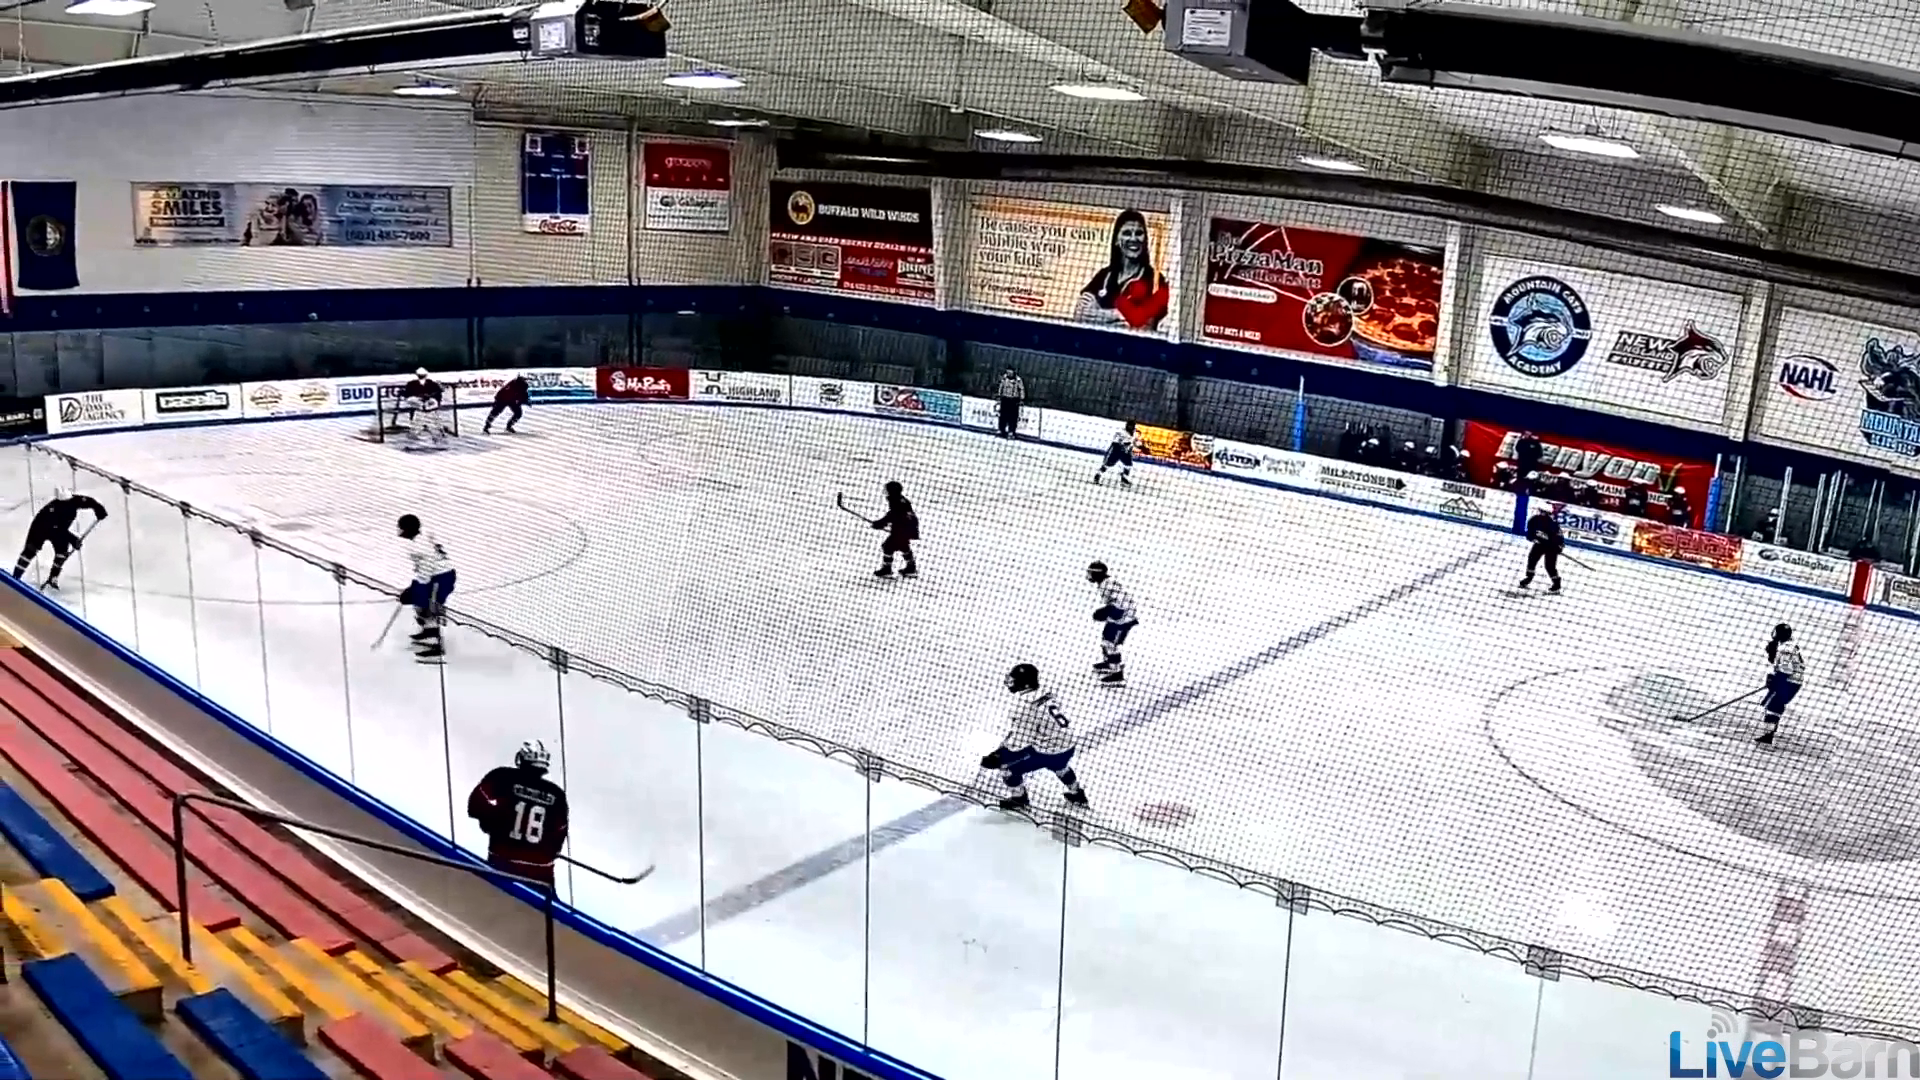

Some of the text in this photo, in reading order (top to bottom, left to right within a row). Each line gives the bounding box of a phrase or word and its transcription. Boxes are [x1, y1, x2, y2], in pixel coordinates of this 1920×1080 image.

[151, 200, 223, 215] SMILES
[861, 208, 886, 220] WILD
[980, 216, 1038, 234] Because
[1040, 224, 1067, 239] you
[1031, 240, 1066, 256] wrap
[979, 249, 1043, 267] your kids
[1503, 280, 1583, 314] MOUNTAIN CATS
[1618, 333, 1671, 350] NEW
[1615, 343, 1674, 360] ENGLAND
[1508, 355, 1562, 374] ACADEMY
[1779, 363, 1836, 394] NAHL
[341, 387, 374, 400] BUD
[728, 385, 780, 398] HIGHLAND
[1862, 411, 1920, 443] MOUNTA
[1782, 554, 1835, 573] Gallagher
[509, 801, 546, 843] 18
